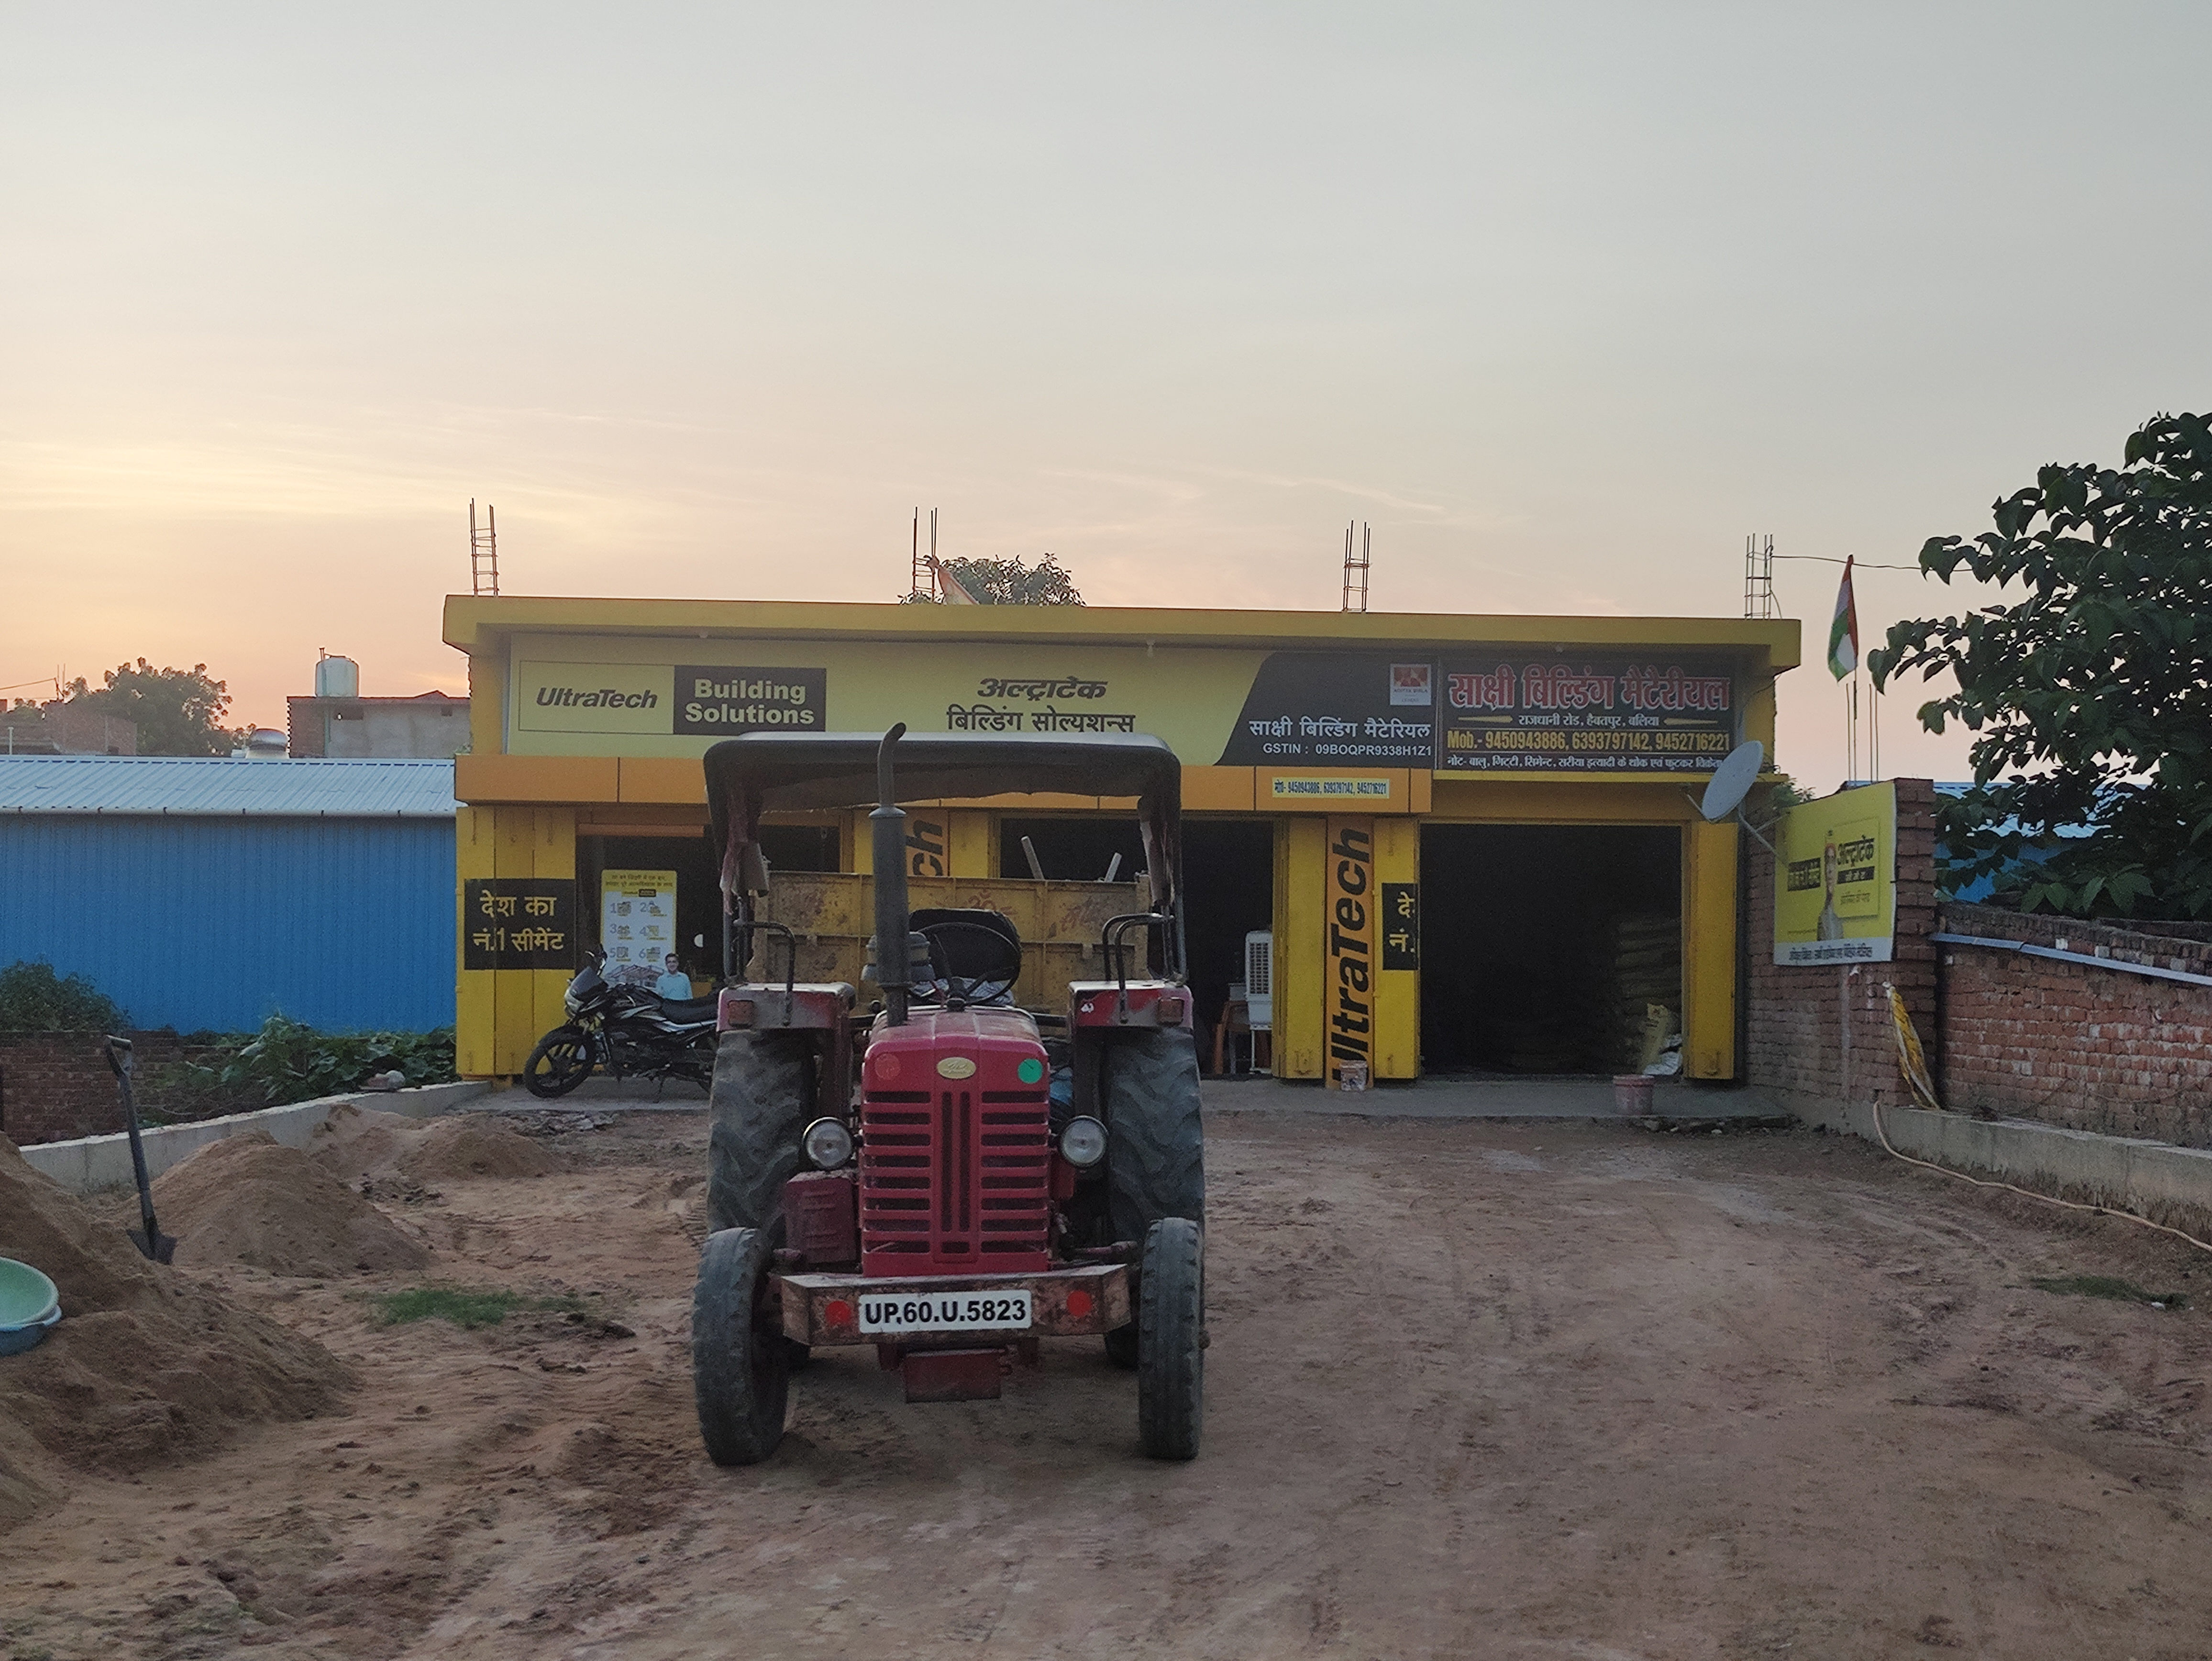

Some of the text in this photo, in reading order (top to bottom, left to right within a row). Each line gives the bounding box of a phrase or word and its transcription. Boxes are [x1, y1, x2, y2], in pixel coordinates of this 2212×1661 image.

[536, 687, 658, 709] UltraTech
[695, 679, 806, 705] Building
[977, 676, 1108, 701] अल्ट्राटेक
[1448, 664, 1516, 711] साक्षी
[1522, 664, 1615, 709] बिल्डिंग
[685, 704, 815, 725] Solutions
[947, 704, 1023, 730] बिल्डिंग
[1518, 713, 1559, 725] राजधानी
[1563, 713, 1584, 726] रोड,
[1249, 716, 1431, 738] साक्षी बिल्डिंग मैटेरियल
[1263, 743, 1301, 754] GSTIN
[1316, 745, 1431, 756] 09BOQPR9338H1Z1
[1448, 731, 1730, 751] Mob.- 9450943886, 6393797142, 9452716221
[1617, 756, 1626, 767] के
[1628, 756, 1648, 767] थोक
[1650, 756, 1663, 768] एवं
[480, 889, 557, 918] देश का
[511, 927, 564, 952] सीमेंट
[1331, 828, 1371, 1082] UltraTech
